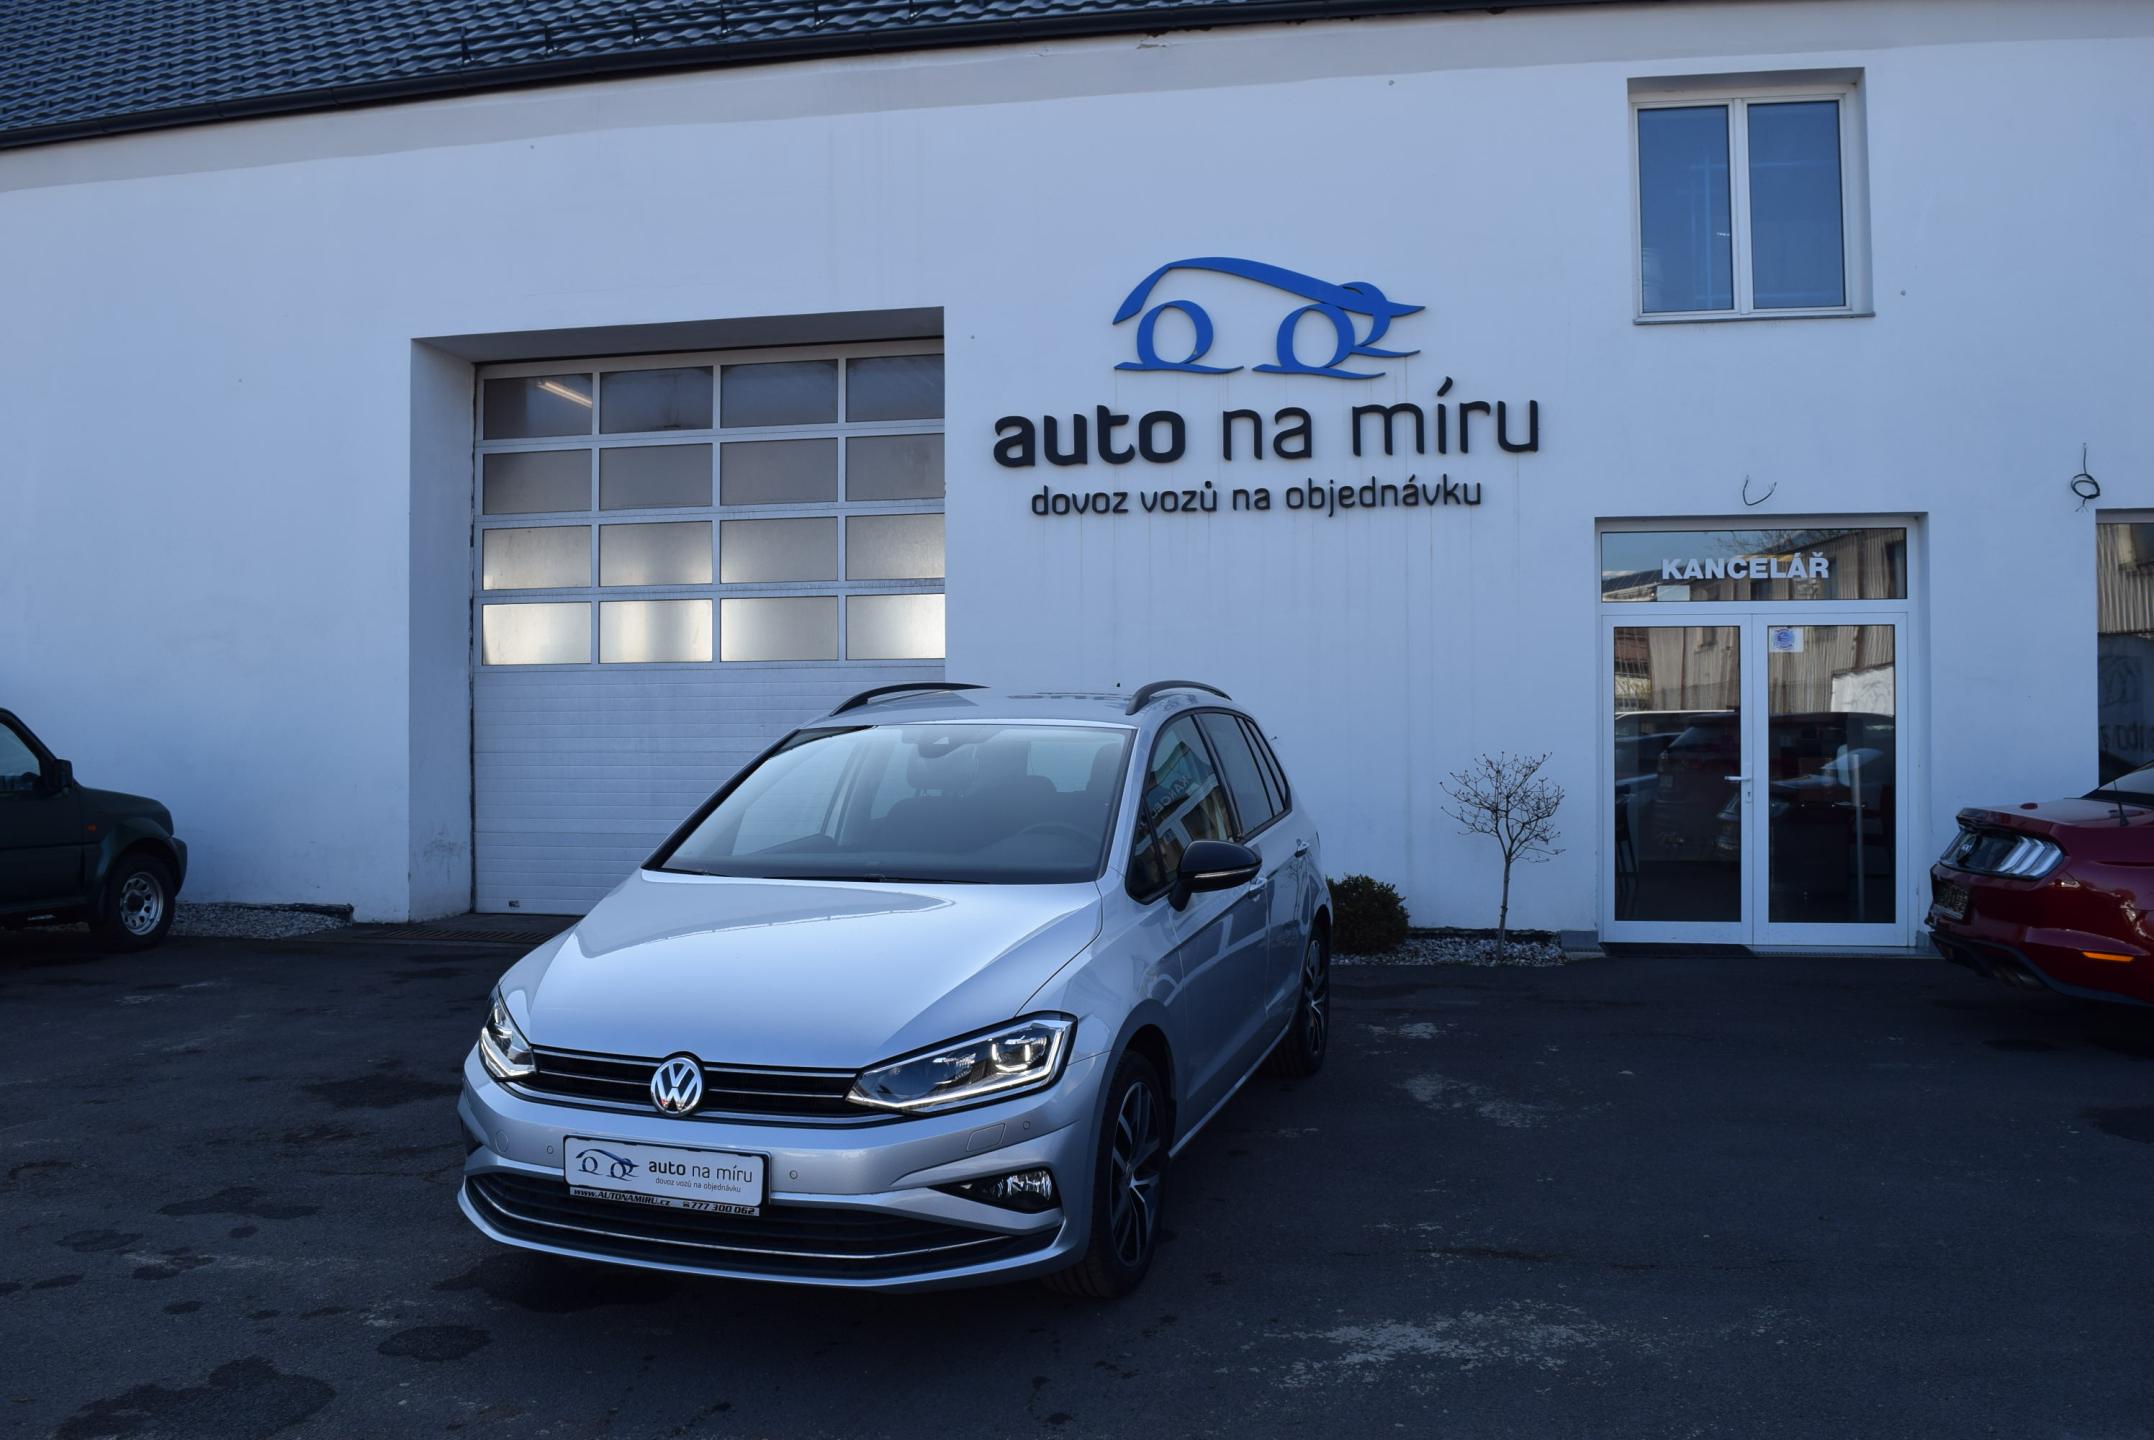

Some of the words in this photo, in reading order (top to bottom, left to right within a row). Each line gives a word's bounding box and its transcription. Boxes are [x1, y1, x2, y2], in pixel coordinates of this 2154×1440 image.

[993, 404, 1186, 468] auto
[1222, 406, 1313, 462] na
[1351, 376, 1539, 457] míru
[1031, 485, 1129, 517] dovoz
[1140, 480, 1218, 514] vozů
[1232, 487, 1271, 512] na
[1285, 474, 1482, 518] objednávku
[1662, 552, 1829, 580] KANCELÁŘ
[648, 1160, 686, 1176] auto
[692, 1165, 710, 1179] na
[716, 1164, 753, 1183] míru
[655, 1177, 675, 1186] dovoz
[676, 1180, 692, 1188] vozů
[703, 1183, 741, 1193] objednávku
[691, 1201, 710, 1210] 777
[712, 1203, 732, 1212] 300
[734, 1206, 755, 1215] 062
